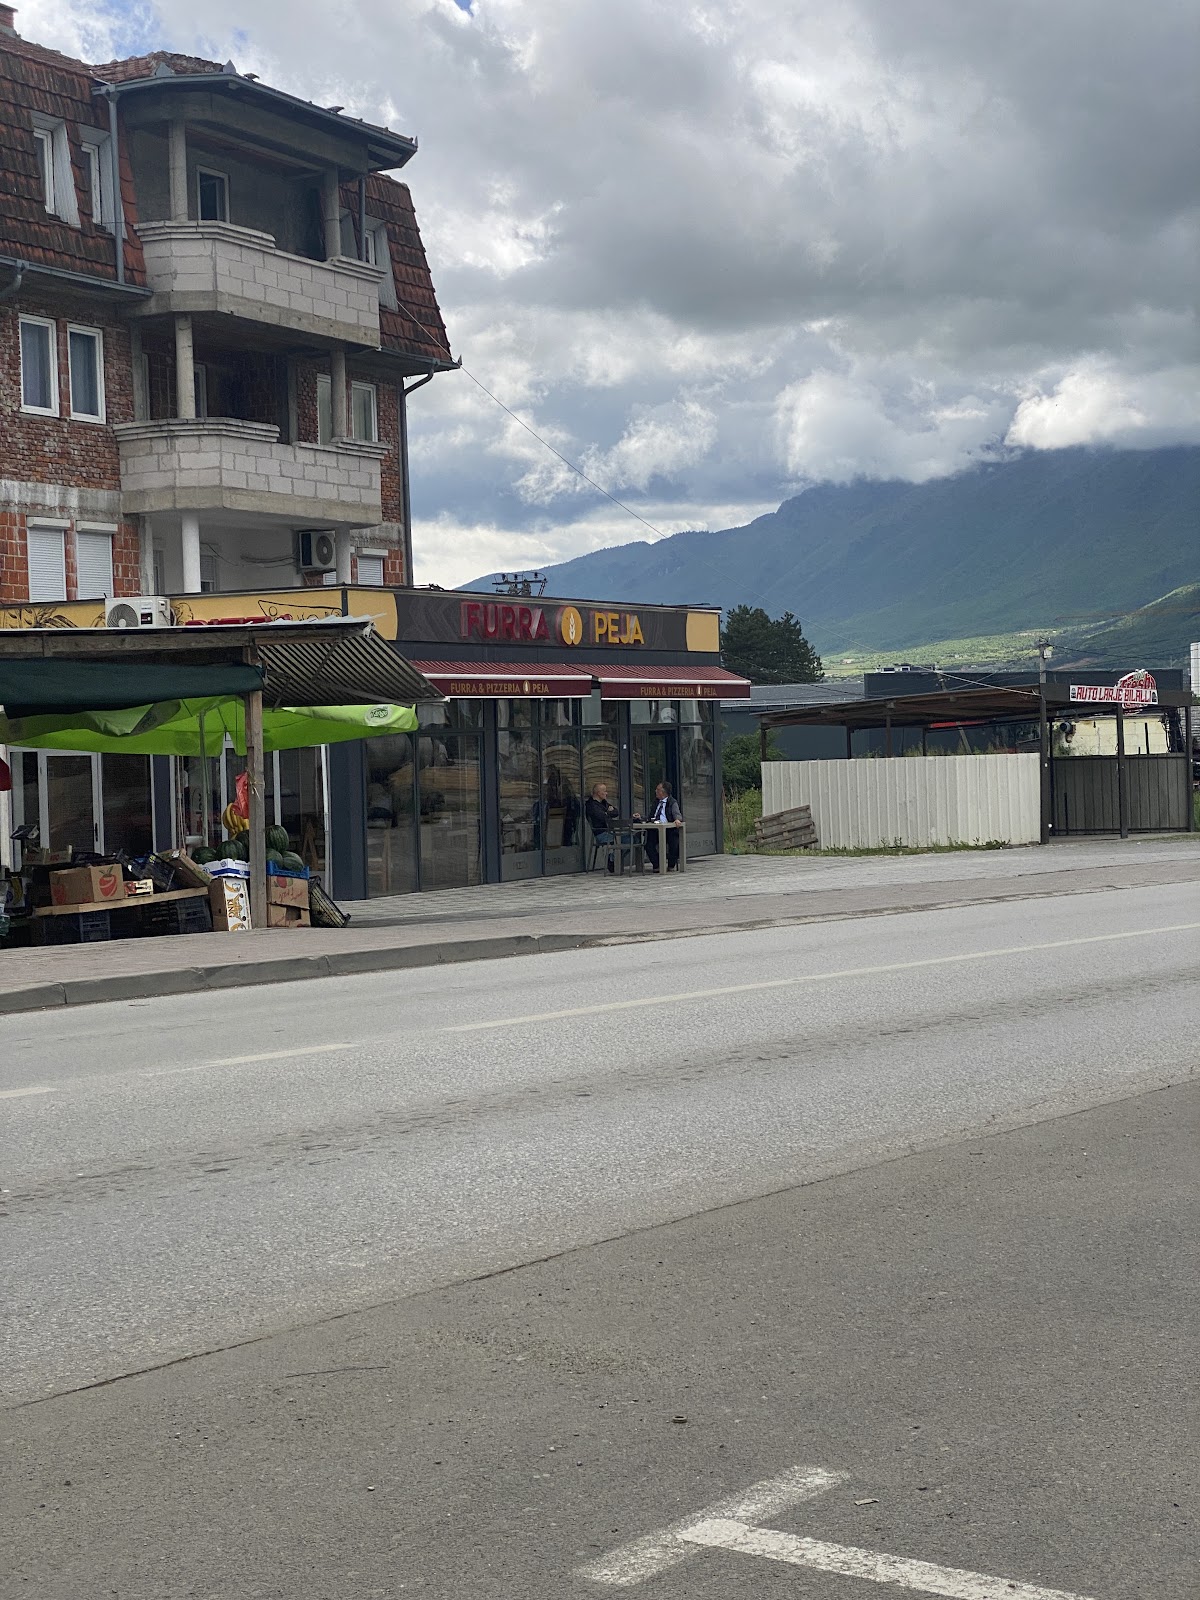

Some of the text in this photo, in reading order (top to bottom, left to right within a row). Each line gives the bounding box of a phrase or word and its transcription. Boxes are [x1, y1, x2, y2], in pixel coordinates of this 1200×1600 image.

[461, 601, 645, 645] FURRA PEJA
[450, 682, 550, 693] FURRA & PIZZERIA PEJA
[640, 686, 717, 696] FURRA & PIZZERIA PEJA
[1076, 686, 1152, 702] AUTO LARJE BILALLI
[227, 899, 235, 918] KING
